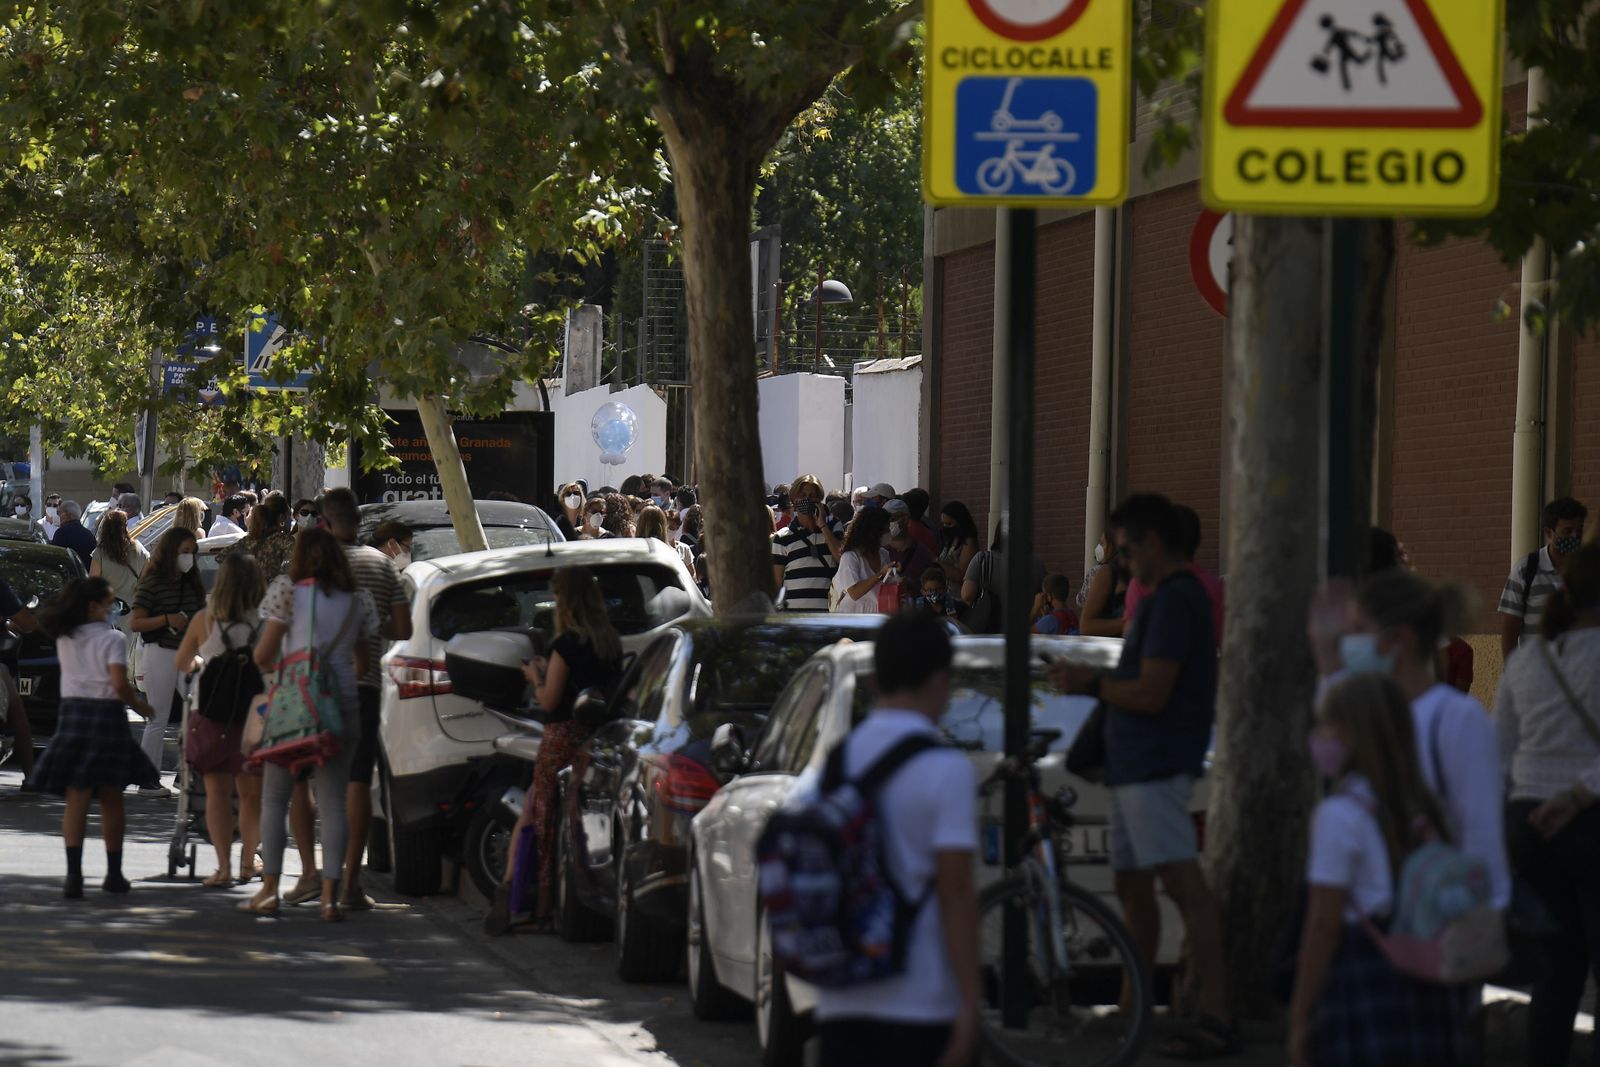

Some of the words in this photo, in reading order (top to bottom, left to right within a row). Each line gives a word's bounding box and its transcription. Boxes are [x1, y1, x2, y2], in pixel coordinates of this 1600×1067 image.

[941, 47, 1113, 69] CICLOCALLE
[1237, 148, 1466, 185] COLEGIO
[460, 436, 512, 448] Granada
[382, 473, 412, 484] Todo
[415, 473, 426, 484] el
